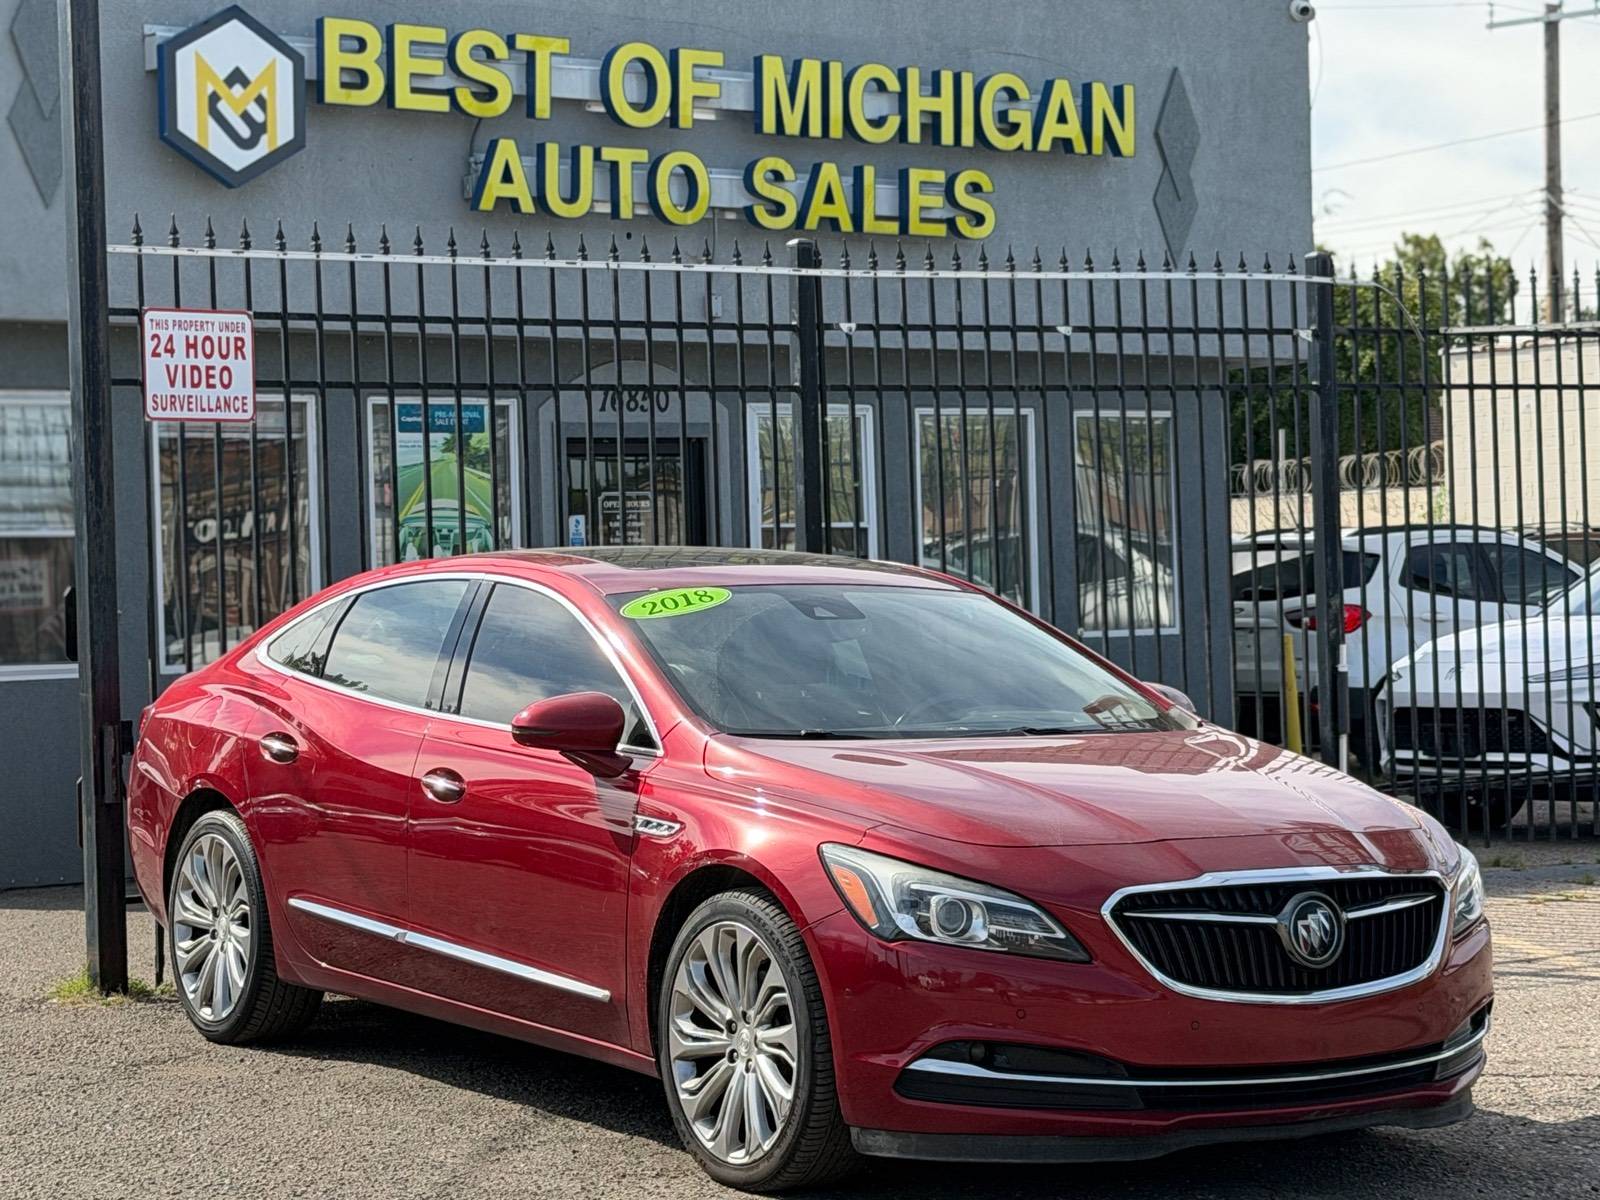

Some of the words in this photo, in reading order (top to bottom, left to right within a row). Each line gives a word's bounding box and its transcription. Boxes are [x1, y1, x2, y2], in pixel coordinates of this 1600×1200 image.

[319, 16, 570, 119] BEST
[604, 42, 724, 129] OF
[757, 54, 1136, 158] MICHIGAN
[472, 138, 711, 226] AUTO
[745, 156, 997, 240] SALES
[149, 318, 169, 331] THIS
[172, 319, 216, 332] PROPERTY
[218, 321, 246, 334] UNDER
[150, 333, 176, 358] 24
[185, 334, 247, 360] HOUR
[165, 363, 233, 390] VIDEO
[151, 393, 249, 413] SURVEILLANCE
[641, 590, 714, 615] 2018
